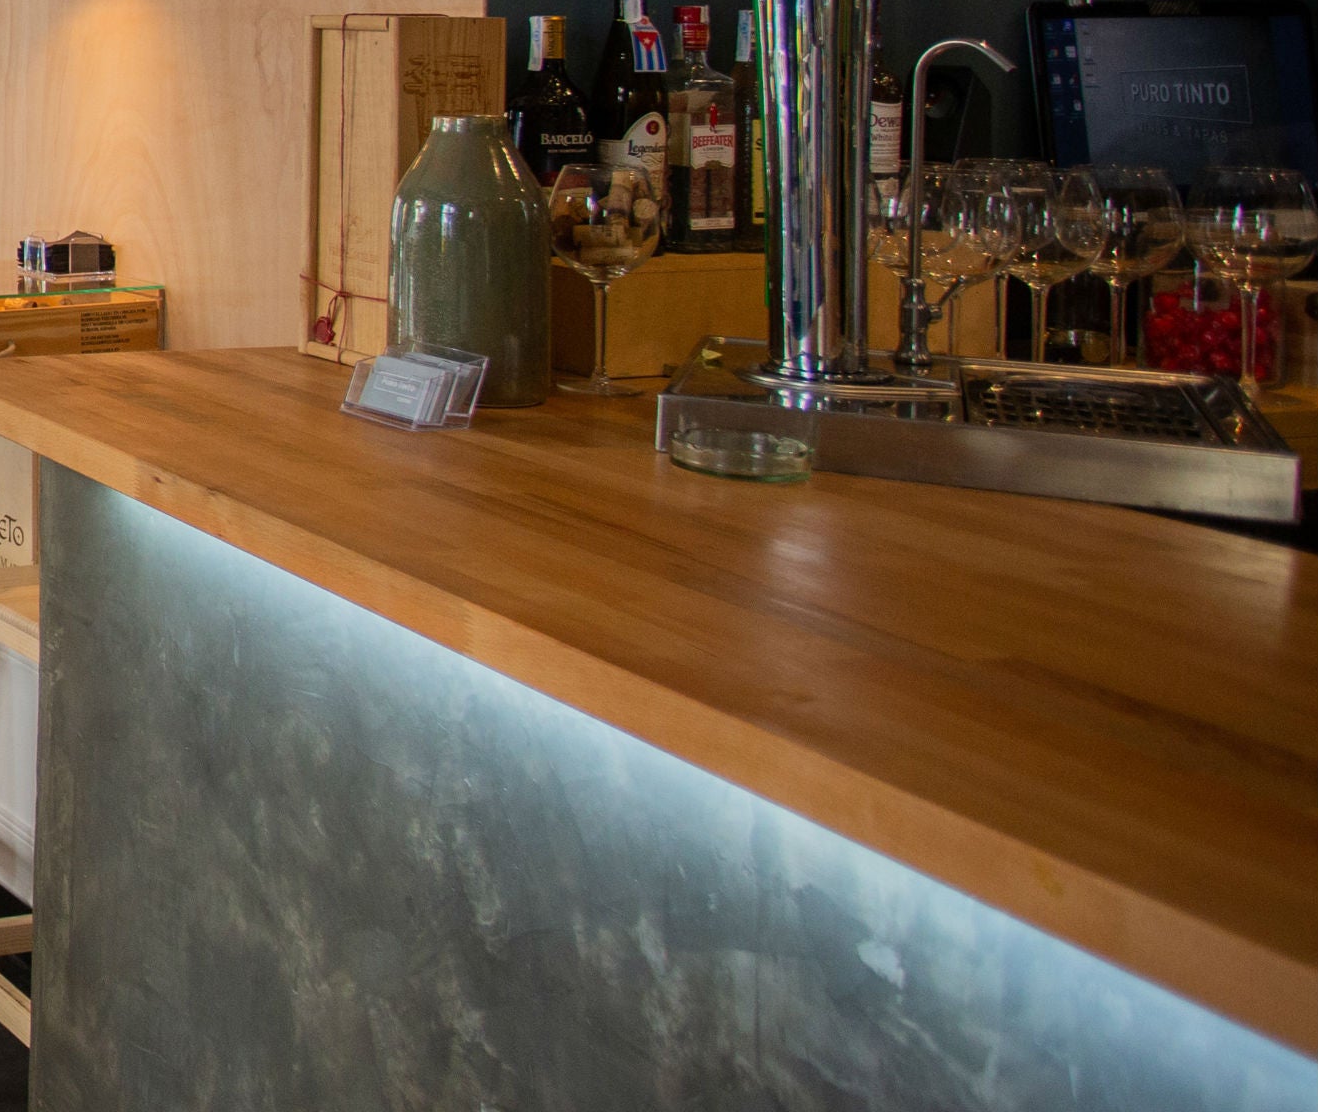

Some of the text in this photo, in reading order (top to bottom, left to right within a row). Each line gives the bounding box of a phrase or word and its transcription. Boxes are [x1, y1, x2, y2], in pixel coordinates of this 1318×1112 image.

[1130, 82, 1231, 105] PURO TINTO
[540, 130, 594, 146] BARCELÓ
[692, 134, 734, 150] BEEFEATER
